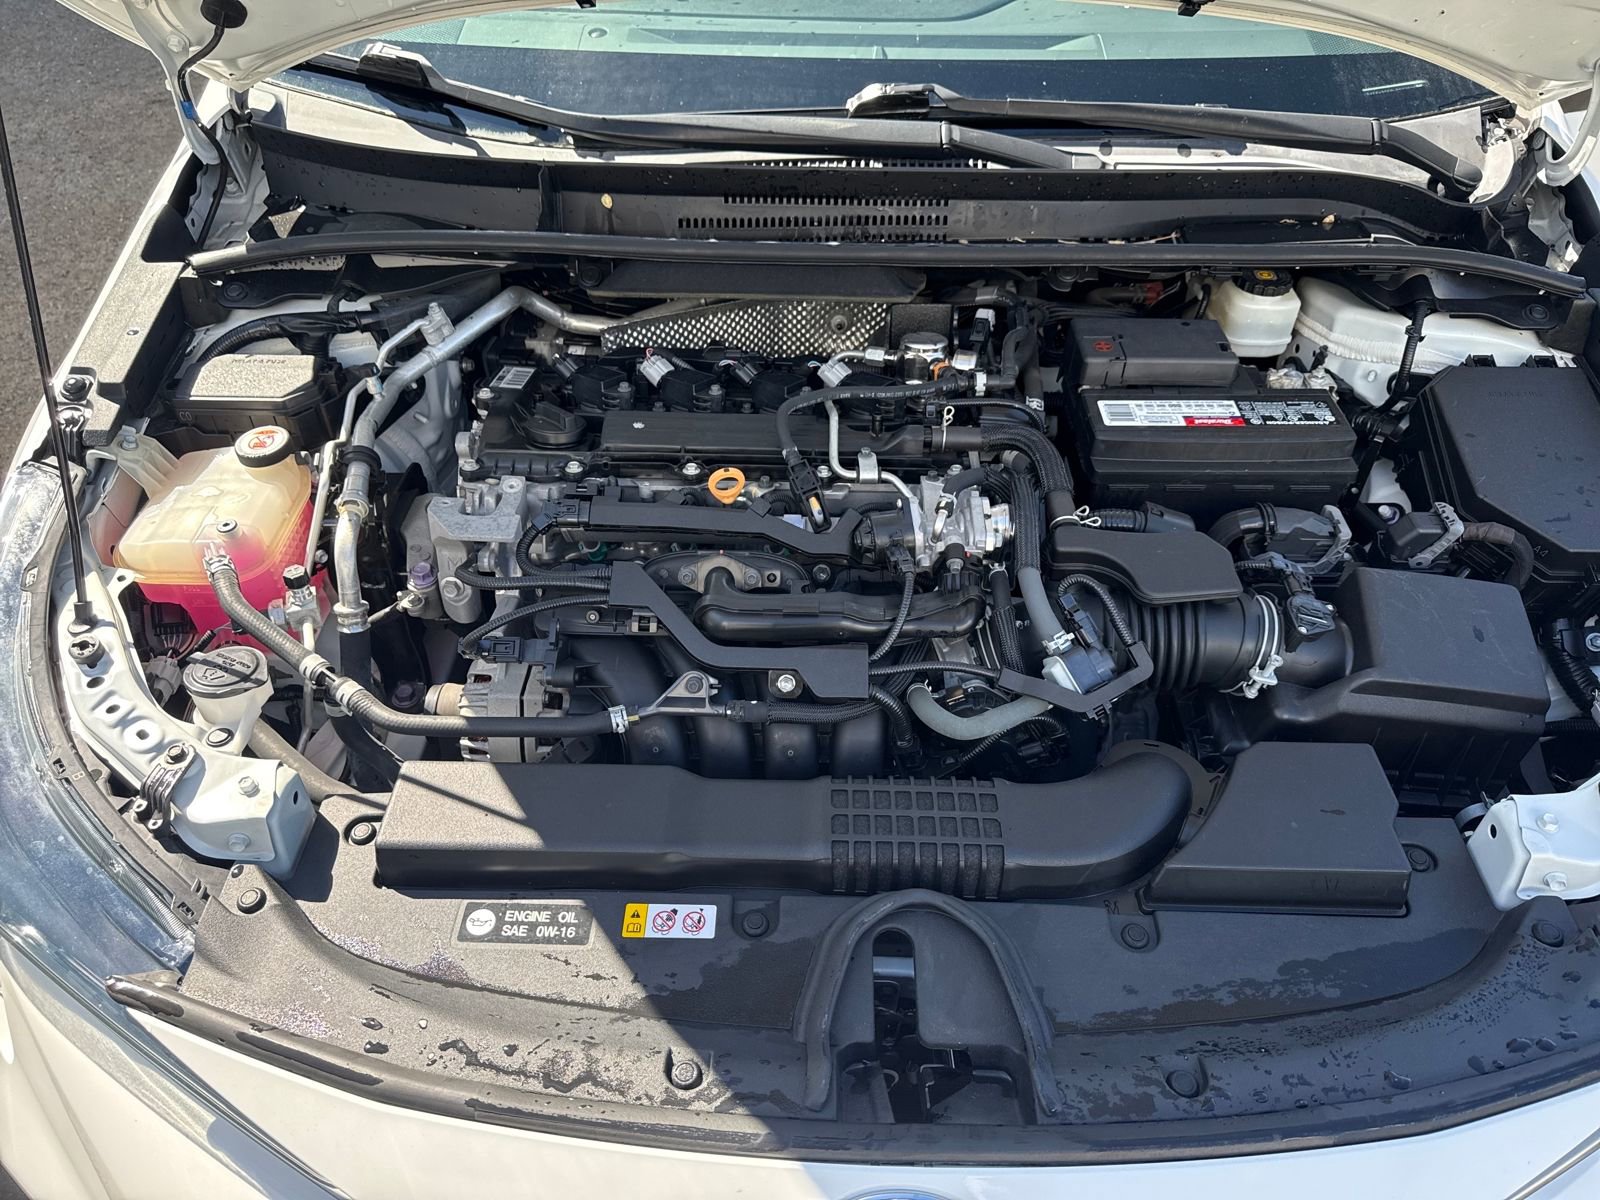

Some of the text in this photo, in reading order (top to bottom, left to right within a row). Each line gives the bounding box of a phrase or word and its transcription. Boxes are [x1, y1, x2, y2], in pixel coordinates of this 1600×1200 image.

[504, 910, 579, 923] ENGINE OIL
[501, 924, 576, 938] SAE 0W-16
